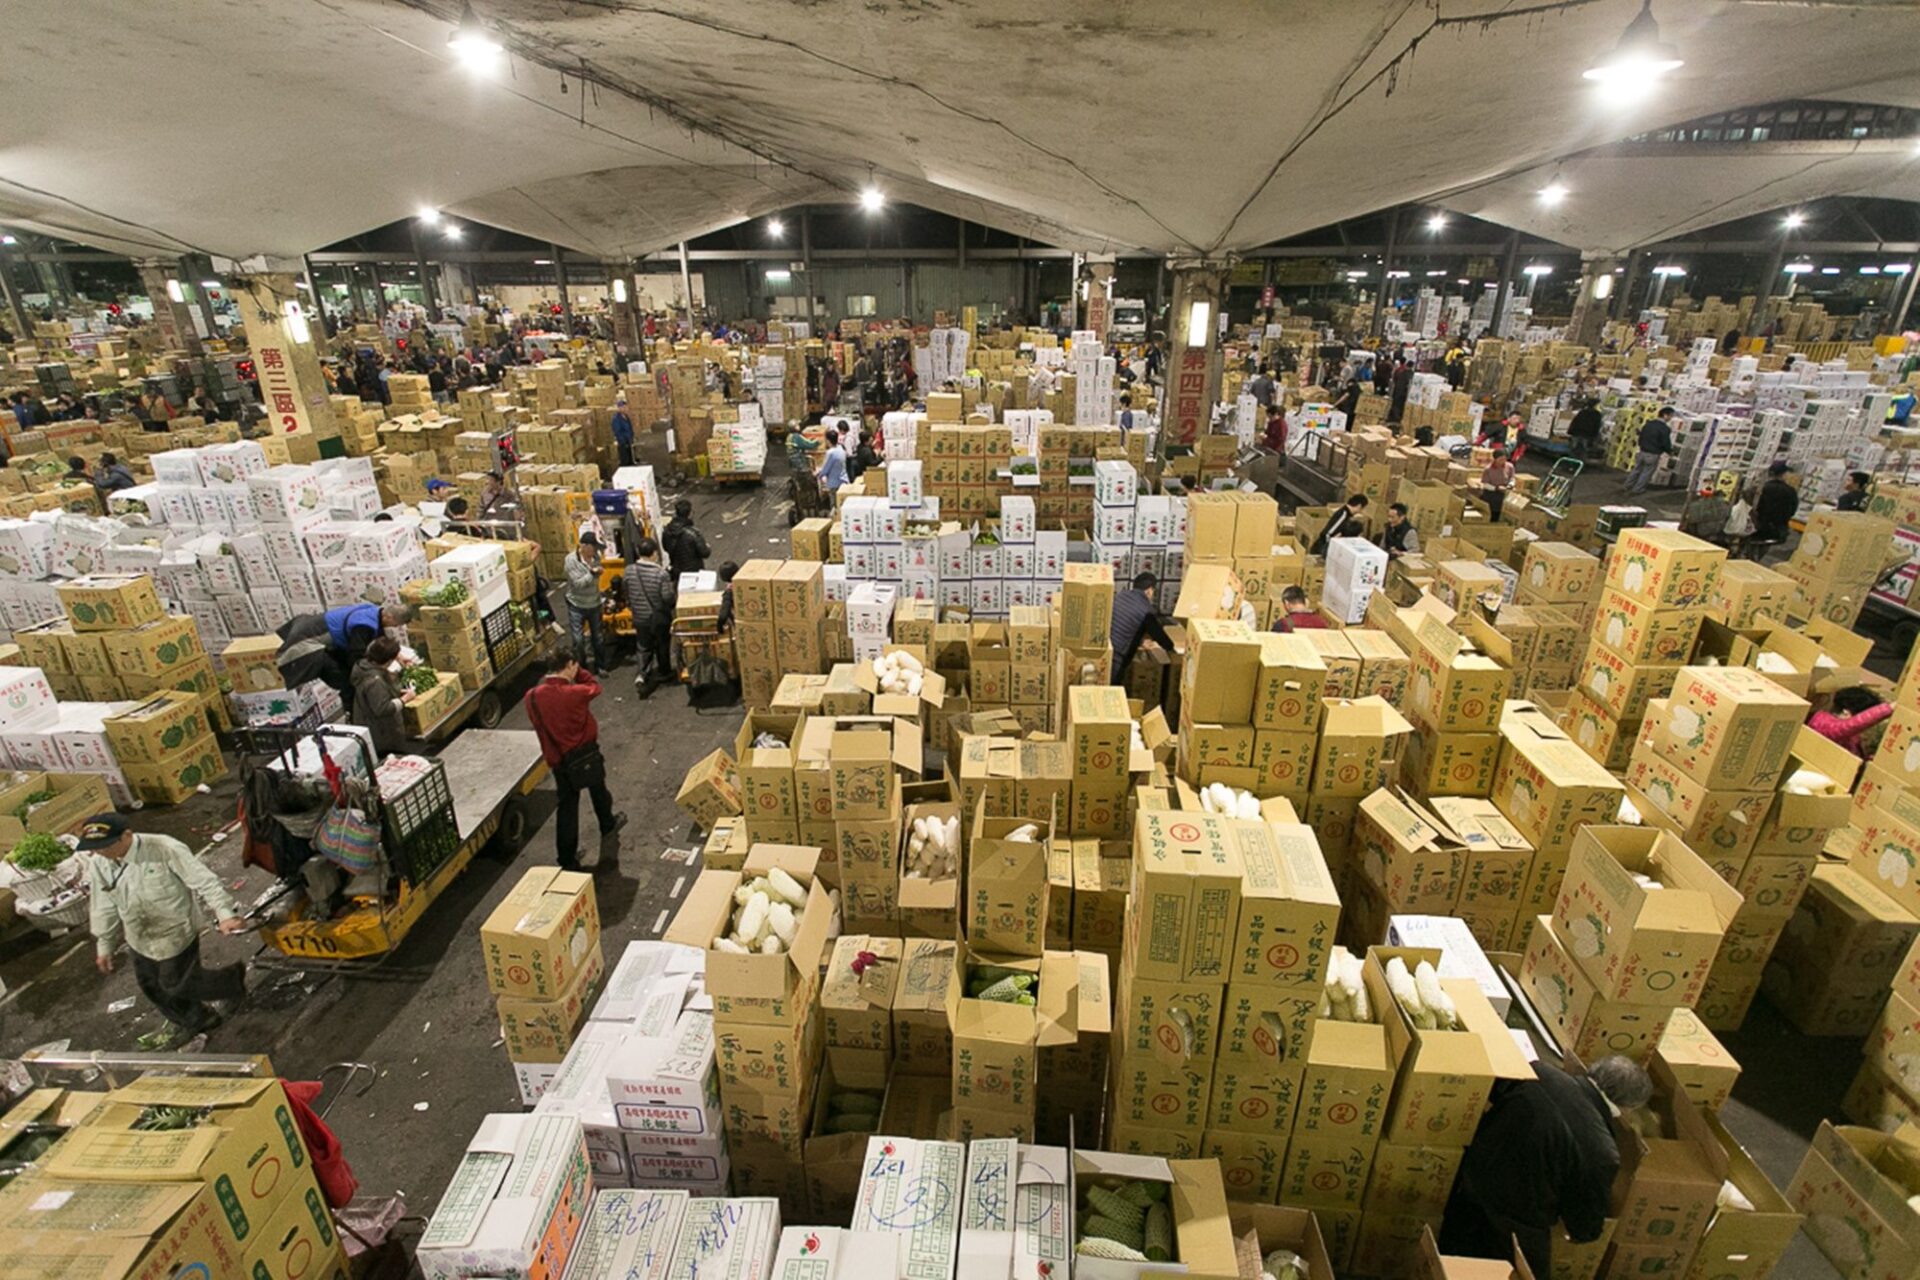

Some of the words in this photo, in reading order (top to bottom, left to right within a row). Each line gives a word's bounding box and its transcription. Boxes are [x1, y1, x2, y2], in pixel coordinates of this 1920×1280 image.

[1626, 538, 1659, 560] 杉林農會
[1610, 594, 1639, 616] 杉林農會
[1647, 572, 1662, 599] 苦瓜
[1595, 647, 1624, 672] 杉林農會
[1626, 629, 1639, 656] 苦瓜
[1304, 680, 1320, 726] 分級包裝
[1486, 680, 1504, 726] 分級包裝
[1611, 684, 1626, 710] 苦瓜
[1115, 734, 1126, 776] 分級包裝
[1296, 742, 1310, 786] 分級包裝
[1362, 746, 1377, 791] 分級包裝
[1476, 745, 1493, 790] 分級包裝
[1025, 892, 1039, 945] 分級包裝
[282, 935, 337, 954] 1710
[1302, 920, 1328, 983] 分級包裝
[532, 950, 547, 996] 分級包裝
[1012, 1055, 1025, 1105] 分級包裝
[1361, 1082, 1384, 1136] 分級包裝
